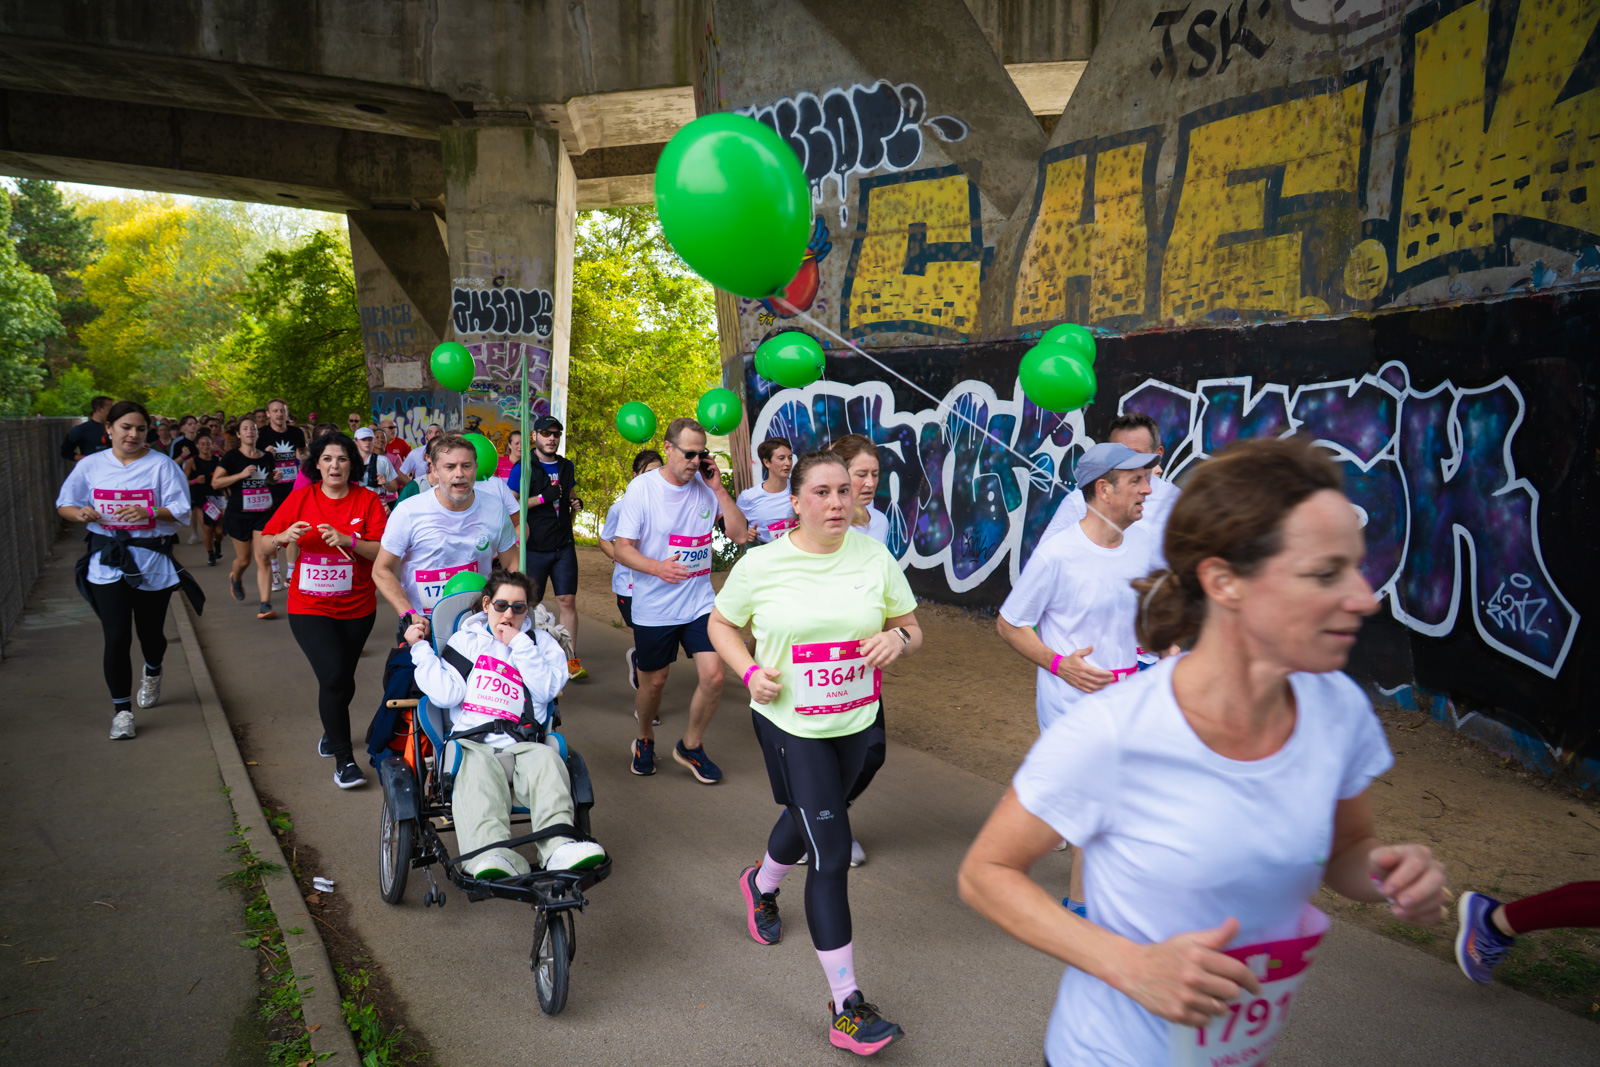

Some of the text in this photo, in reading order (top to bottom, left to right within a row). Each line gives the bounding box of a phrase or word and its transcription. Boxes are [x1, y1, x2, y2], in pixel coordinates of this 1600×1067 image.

[306, 568, 347, 581] 12324
[803, 664, 866, 687] 13641
[475, 674, 520, 701] 17903
[825, 689, 849, 698] ANNA
[476, 693, 510, 706] CHARLOTTE
